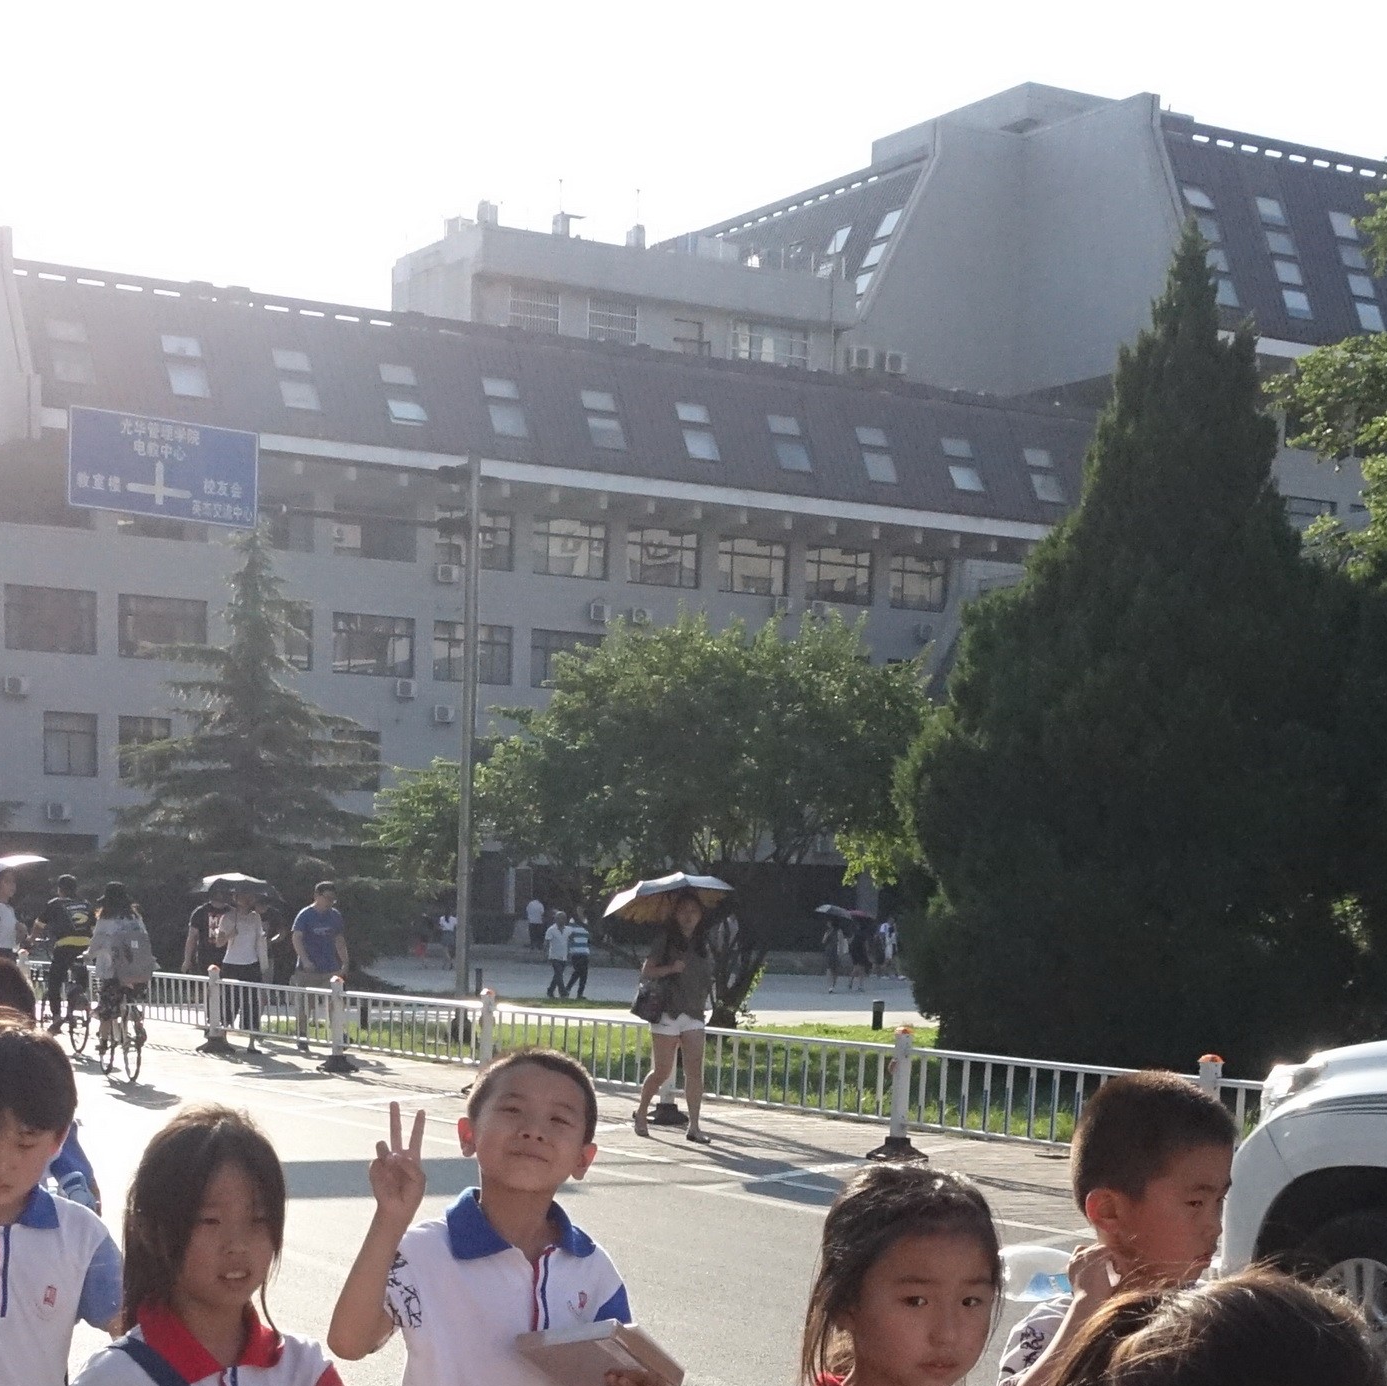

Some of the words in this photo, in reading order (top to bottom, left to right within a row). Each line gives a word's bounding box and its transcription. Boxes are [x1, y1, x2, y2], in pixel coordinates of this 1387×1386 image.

[120, 418, 200, 446] 光华管理学院
[133, 439, 186, 461] 电教中心
[203, 477, 243, 499] 校友会
